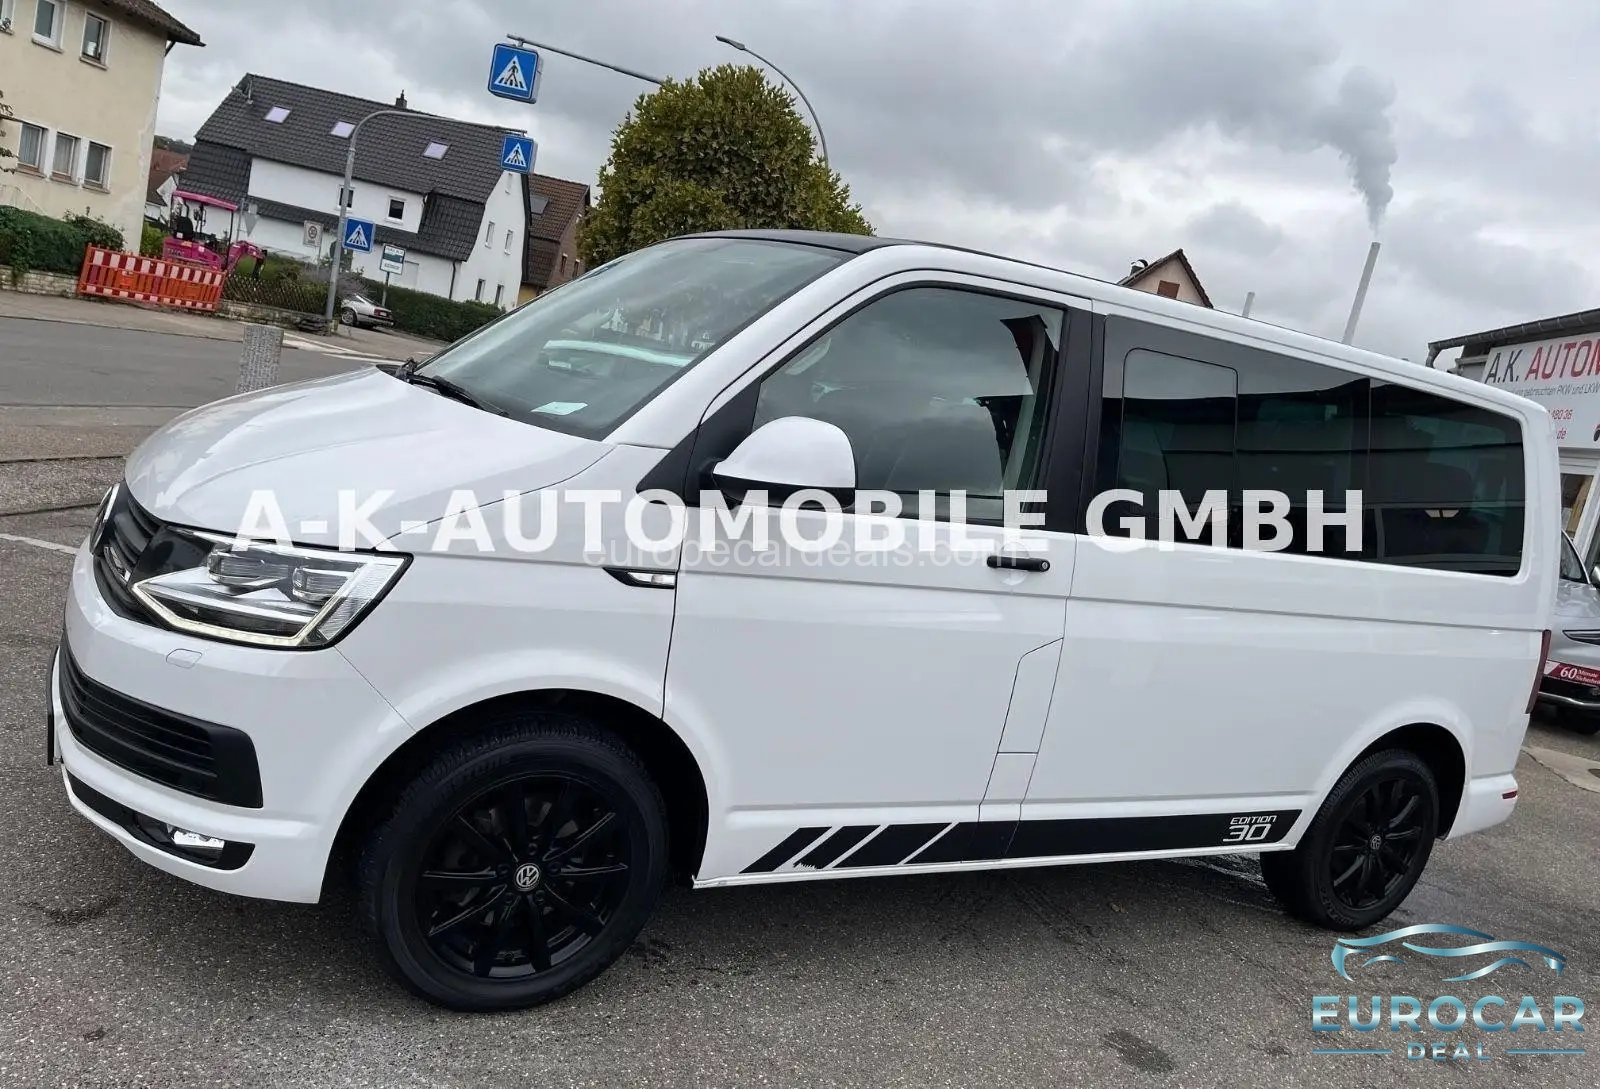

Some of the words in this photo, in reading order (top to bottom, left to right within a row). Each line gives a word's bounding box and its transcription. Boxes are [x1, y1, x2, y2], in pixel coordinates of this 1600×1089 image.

[1485, 349, 1523, 383] A.K.
[1560, 667, 1577, 679] 60
[1229, 815, 1277, 825] EDITION
[1223, 823, 1272, 842] 30
